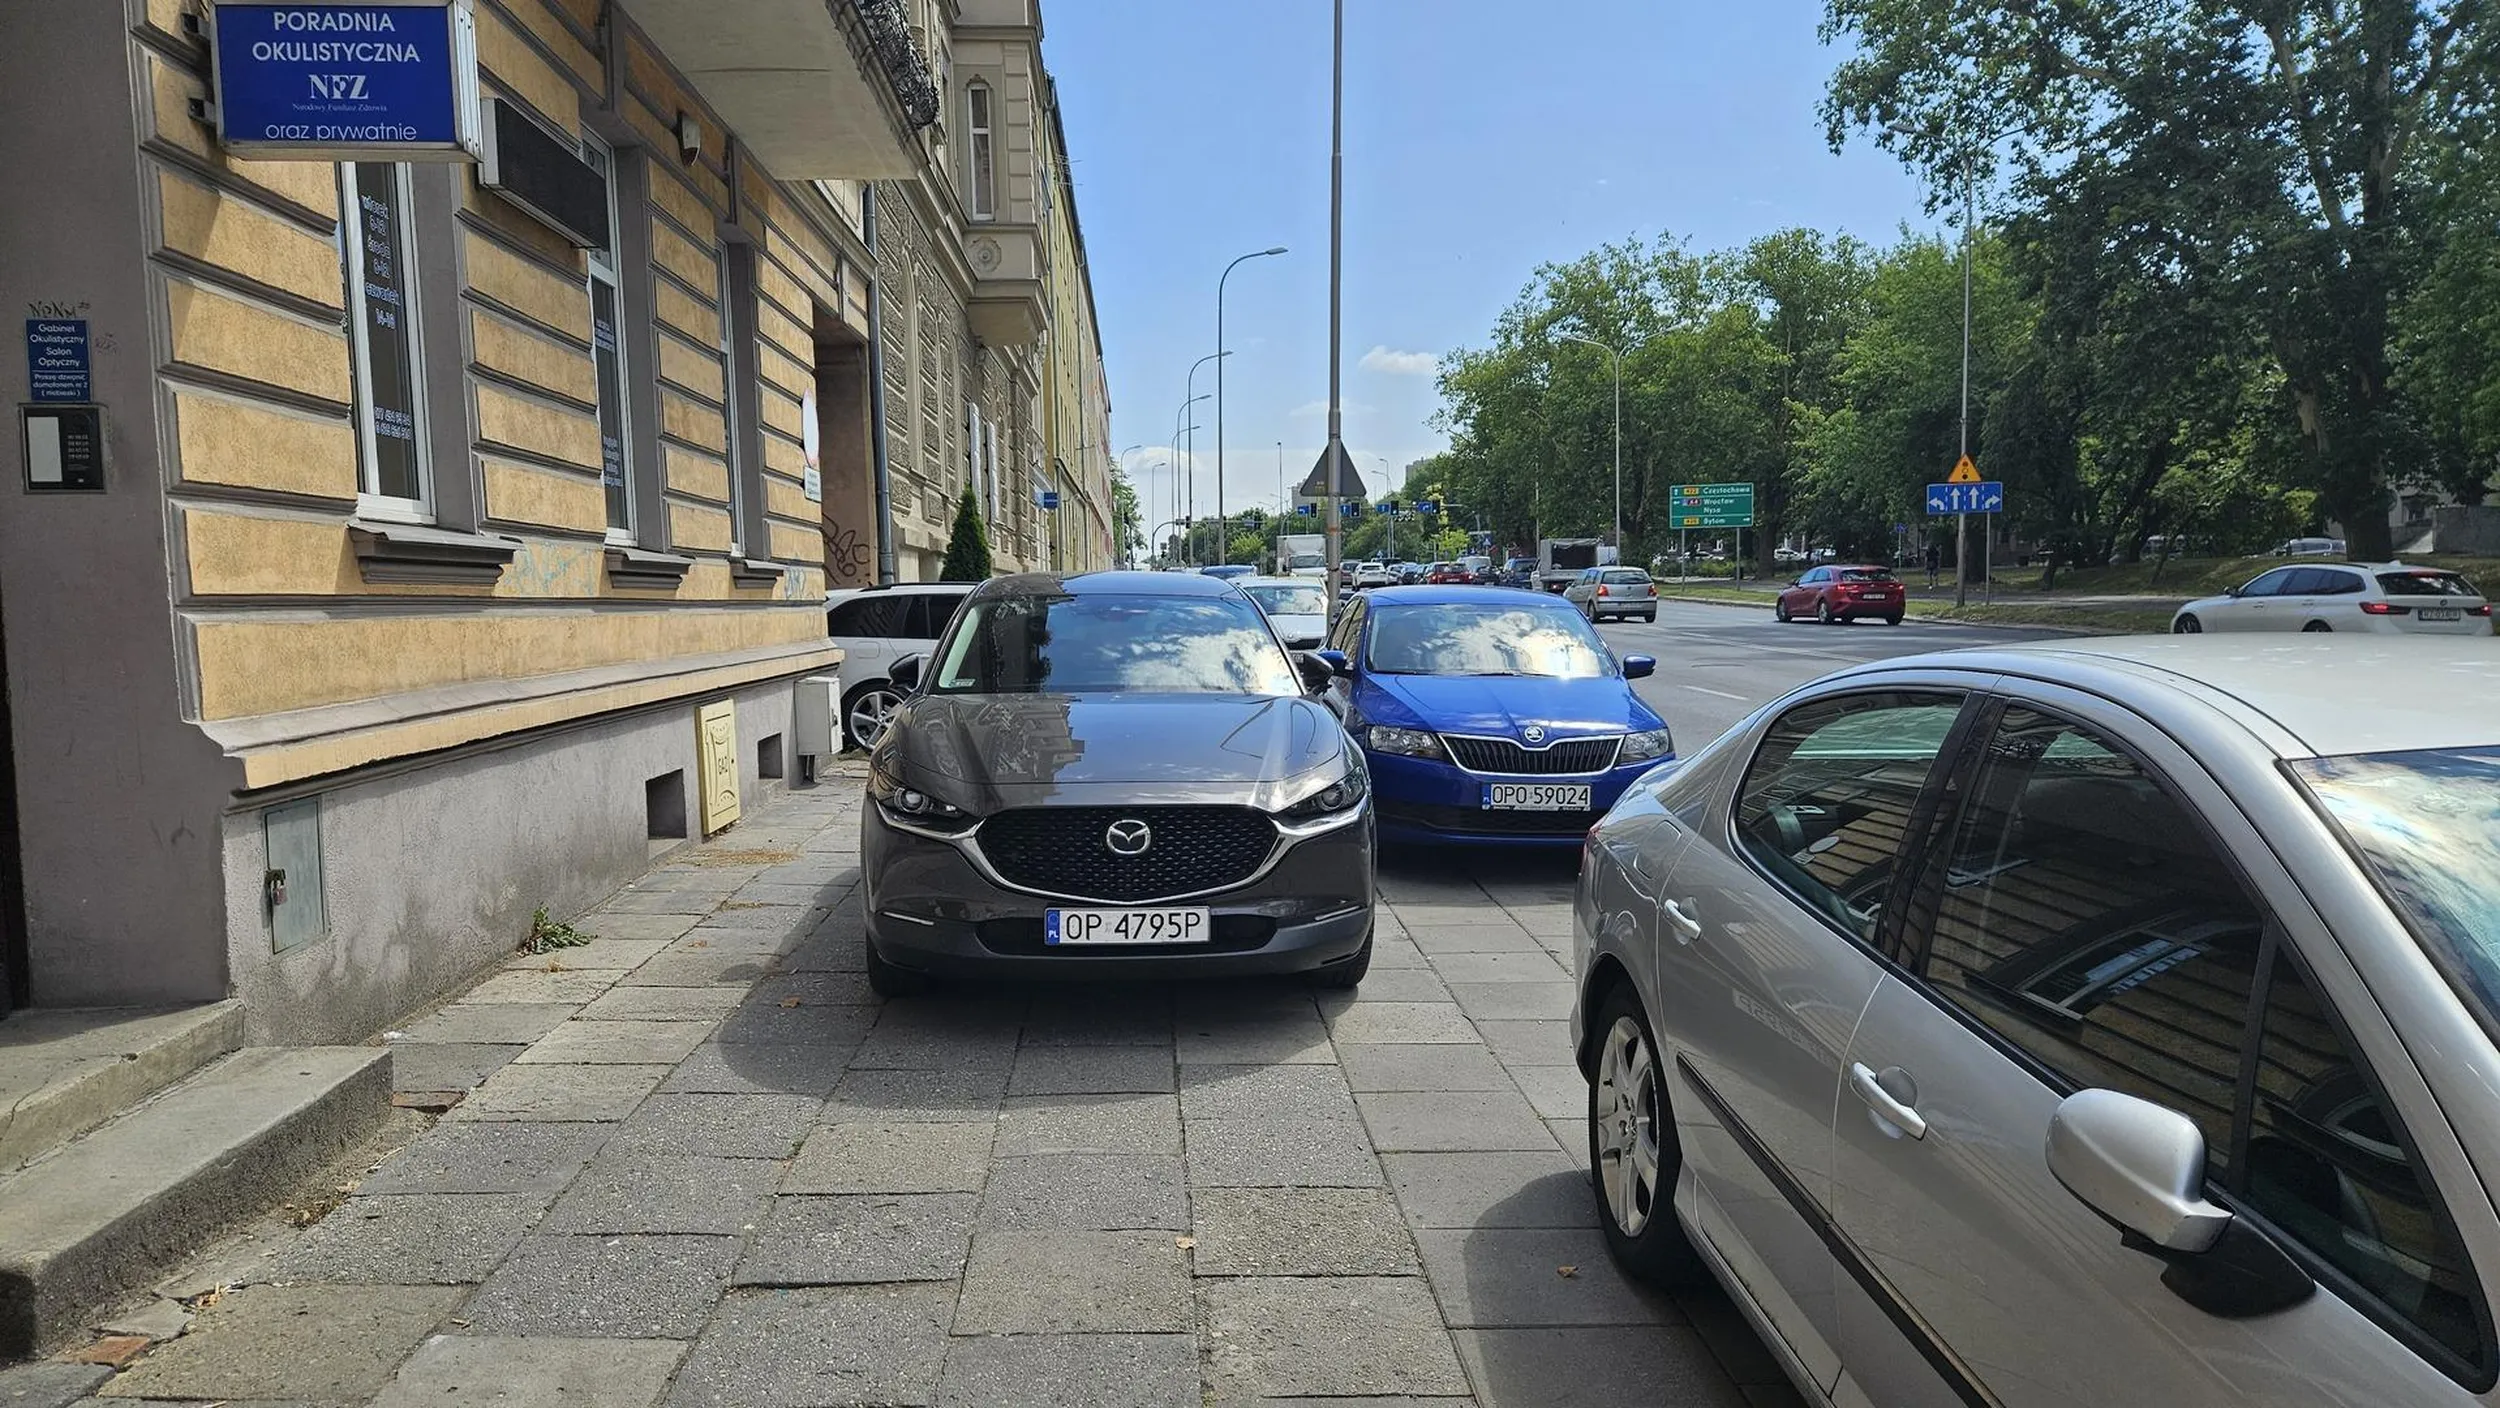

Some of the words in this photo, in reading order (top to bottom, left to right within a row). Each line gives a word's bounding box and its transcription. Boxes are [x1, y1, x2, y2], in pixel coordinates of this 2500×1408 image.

[273, 12, 396, 32] PORADNIA
[252, 42, 421, 63] OKULISTYCZNA
[308, 74, 369, 100] NFZ
[265, 124, 310, 140] oraz
[316, 122, 417, 142] prywatnie
[38, 323, 76, 333] Gabinet
[29, 334, 85, 345] Okulistyczny
[45, 346, 73, 356] Salon
[38, 357, 80, 367] Optyczny
[1492, 786, 1527, 804] OPO
[1533, 787, 1589, 805] 59024
[1048, 930, 1059, 938] PL
[1066, 913, 1102, 940] OP
[1114, 912, 1200, 940] 4795P
